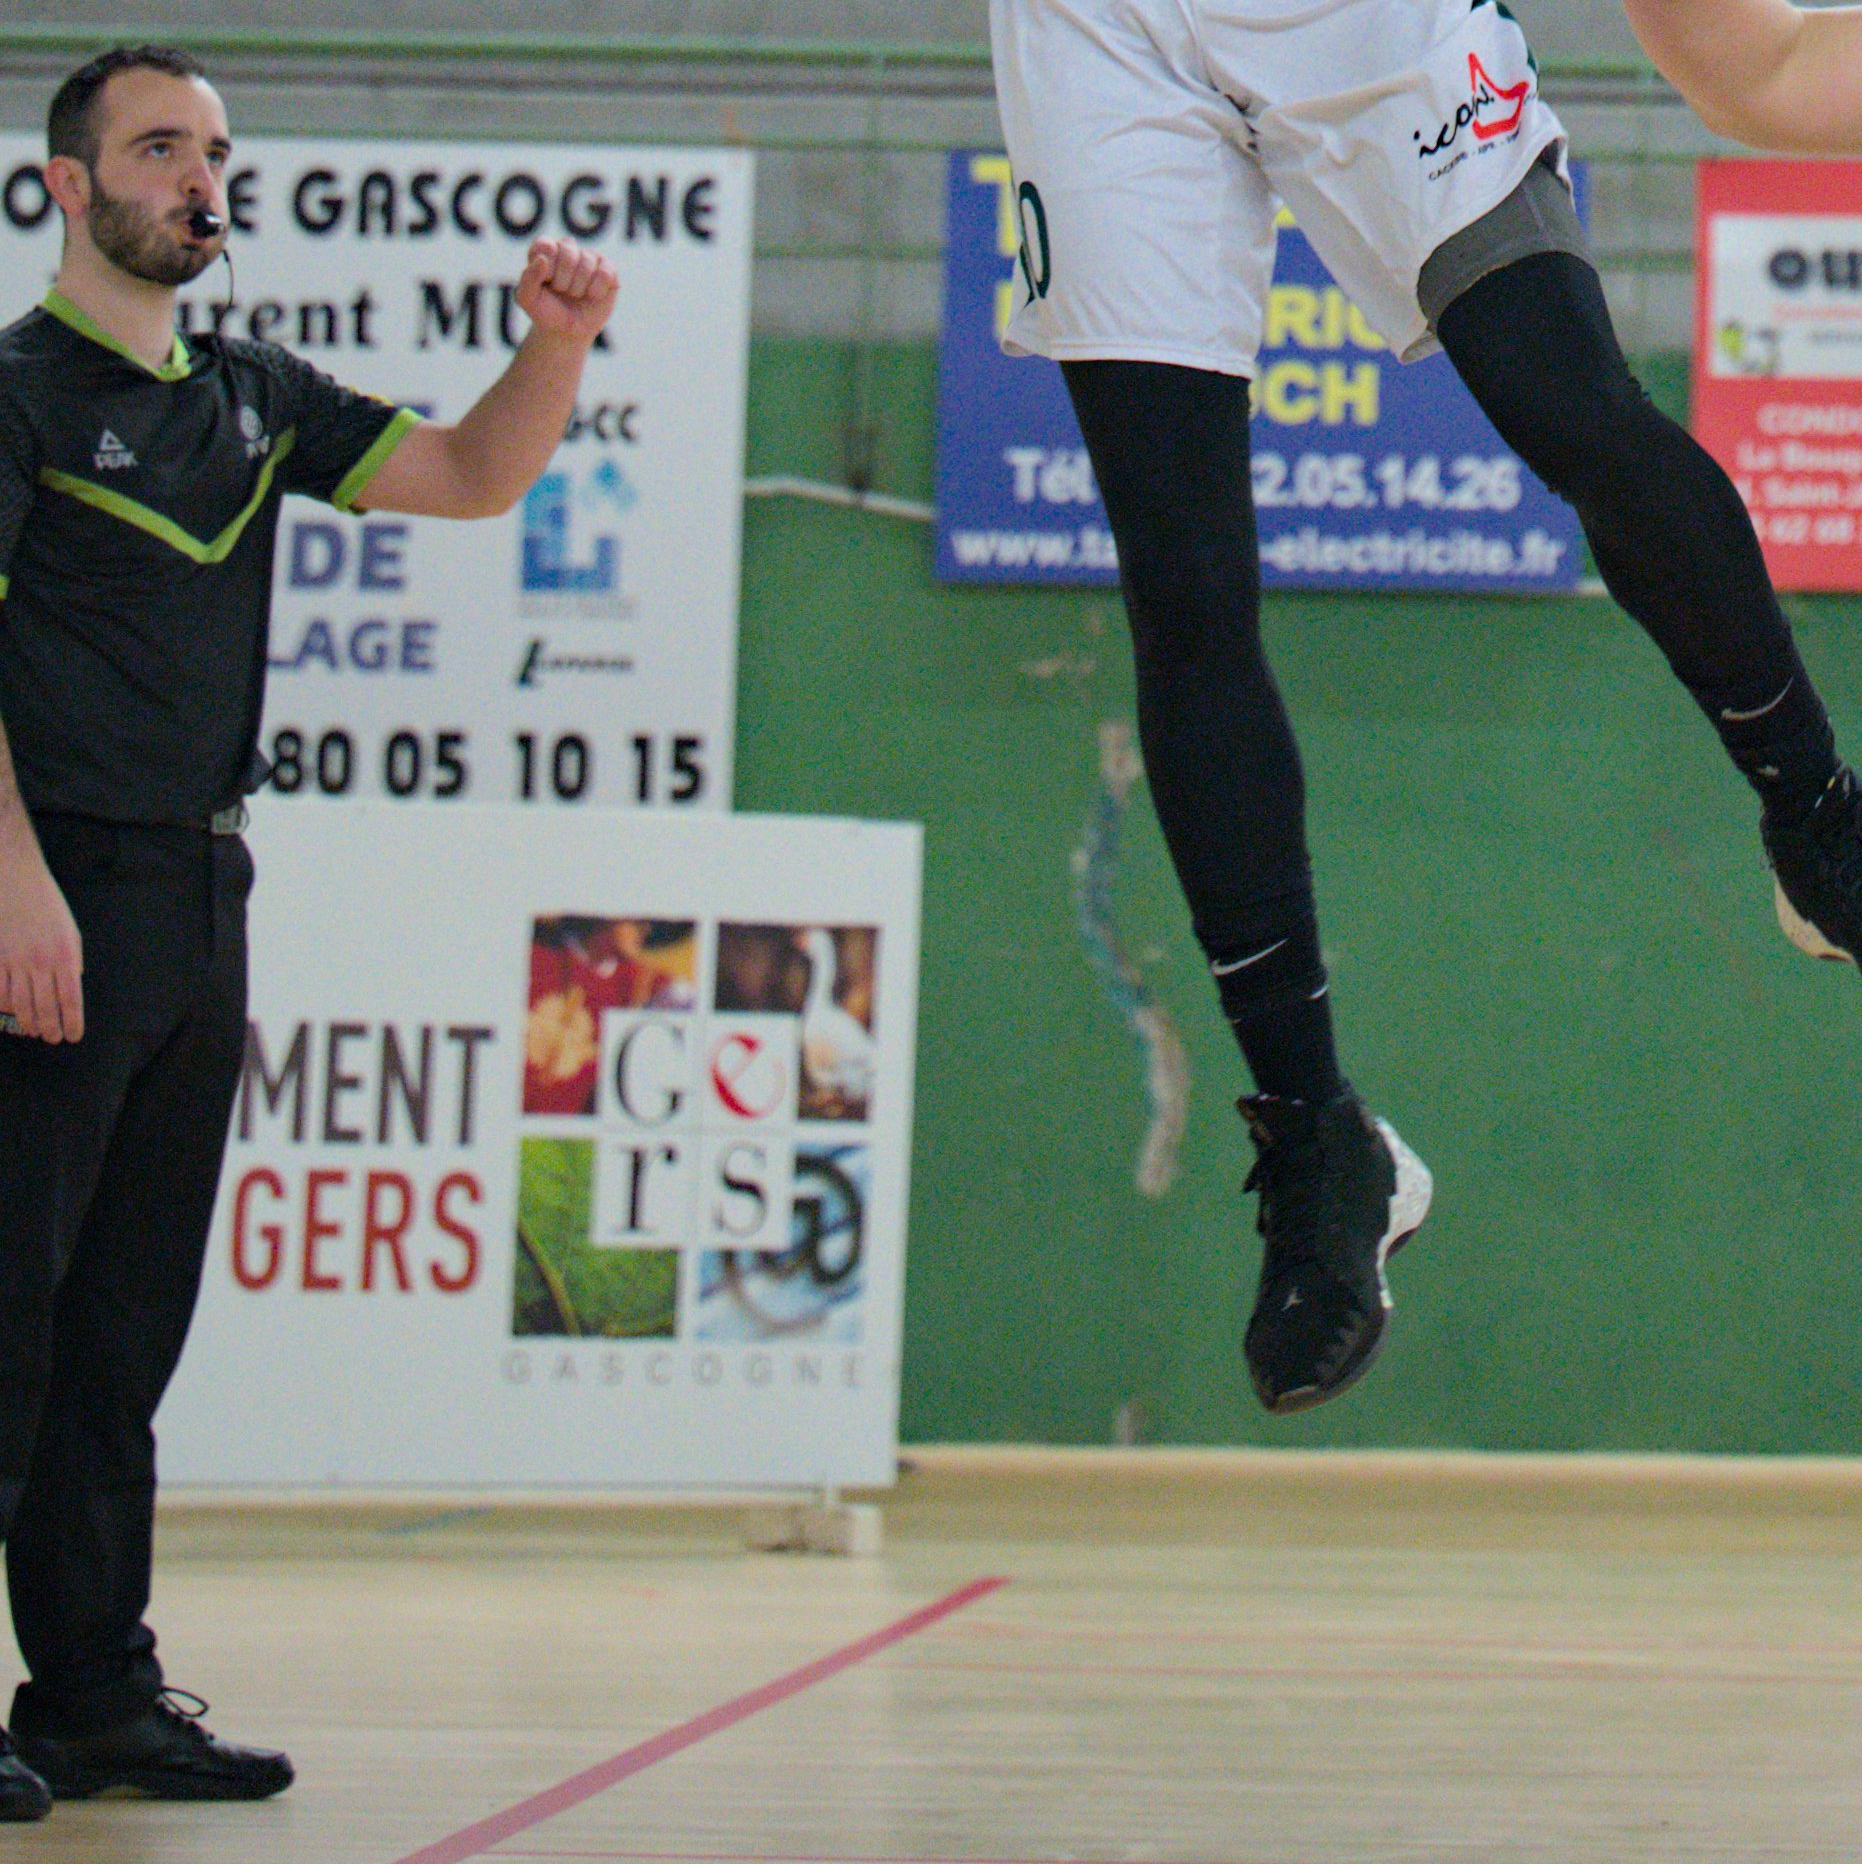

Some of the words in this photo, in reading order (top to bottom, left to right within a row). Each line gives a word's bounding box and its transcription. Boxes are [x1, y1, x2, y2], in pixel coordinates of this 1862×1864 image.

[294, 169, 716, 242] GASCOGNE
[1250, 452, 1523, 513] 2.05.14.26
[288, 521, 409, 591] DE
[270, 728, 354, 796] 80
[384, 729, 468, 800] 05
[517, 732, 590, 801] 10
[631, 733, 708, 805] 15
[229, 1166, 486, 1294] GERS
[507, 1350, 865, 1388] GASCOGNE
